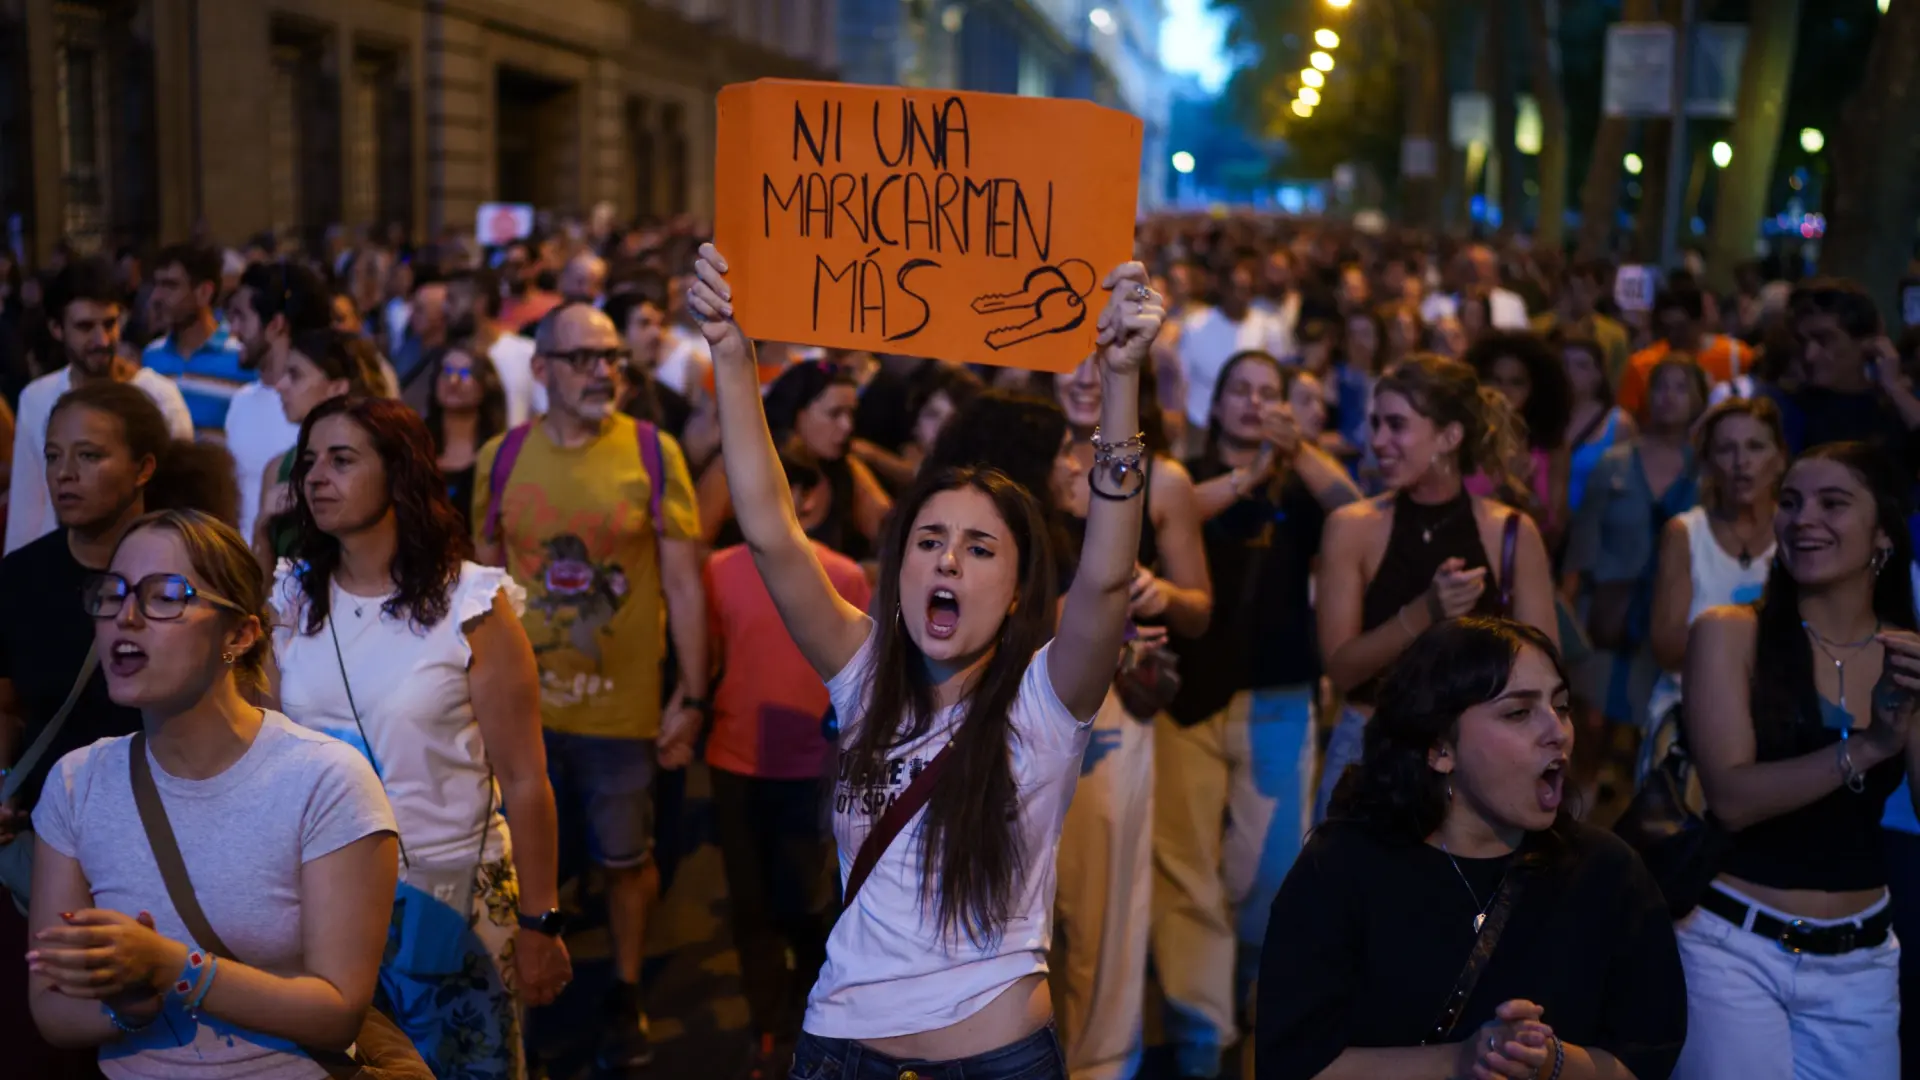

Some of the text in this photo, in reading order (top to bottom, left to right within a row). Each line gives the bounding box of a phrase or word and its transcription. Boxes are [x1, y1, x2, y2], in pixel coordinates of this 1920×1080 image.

[793, 97, 970, 171] NI UNA
[763, 172, 1053, 263] MARICARMEN
[813, 247, 942, 342] MÁS
